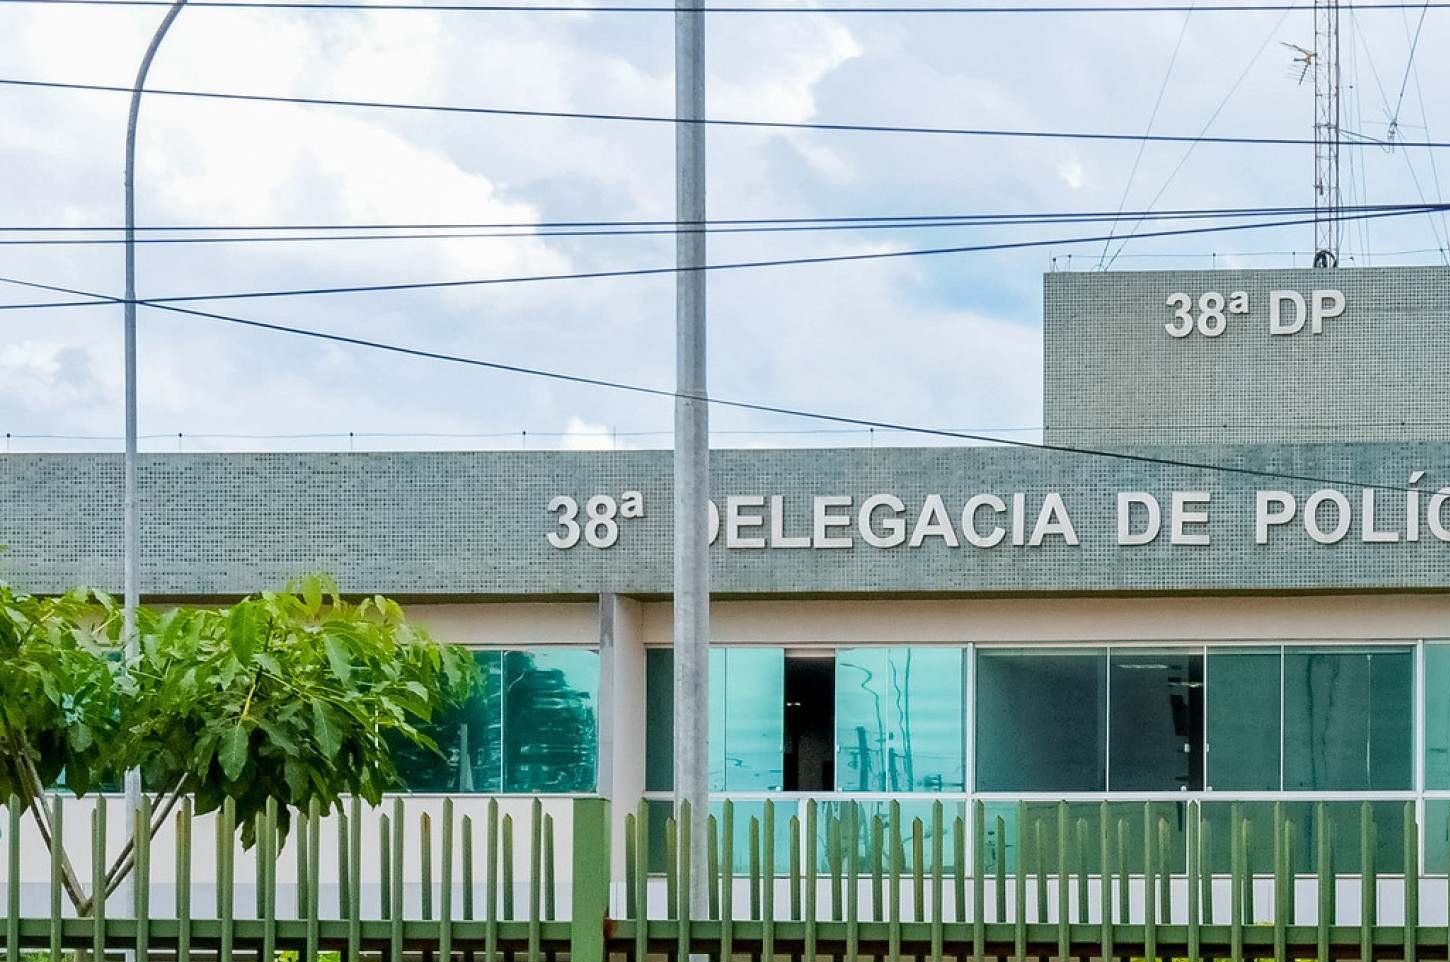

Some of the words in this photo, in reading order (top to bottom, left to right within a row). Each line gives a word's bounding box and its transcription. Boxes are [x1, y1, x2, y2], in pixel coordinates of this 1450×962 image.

[1165, 291, 1249, 338] 38ª
[1270, 290, 1346, 335] DP
[546, 490, 645, 549] 38ª
[706, 492, 1080, 549] ELEGACIA
[1117, 491, 1211, 546] DE
